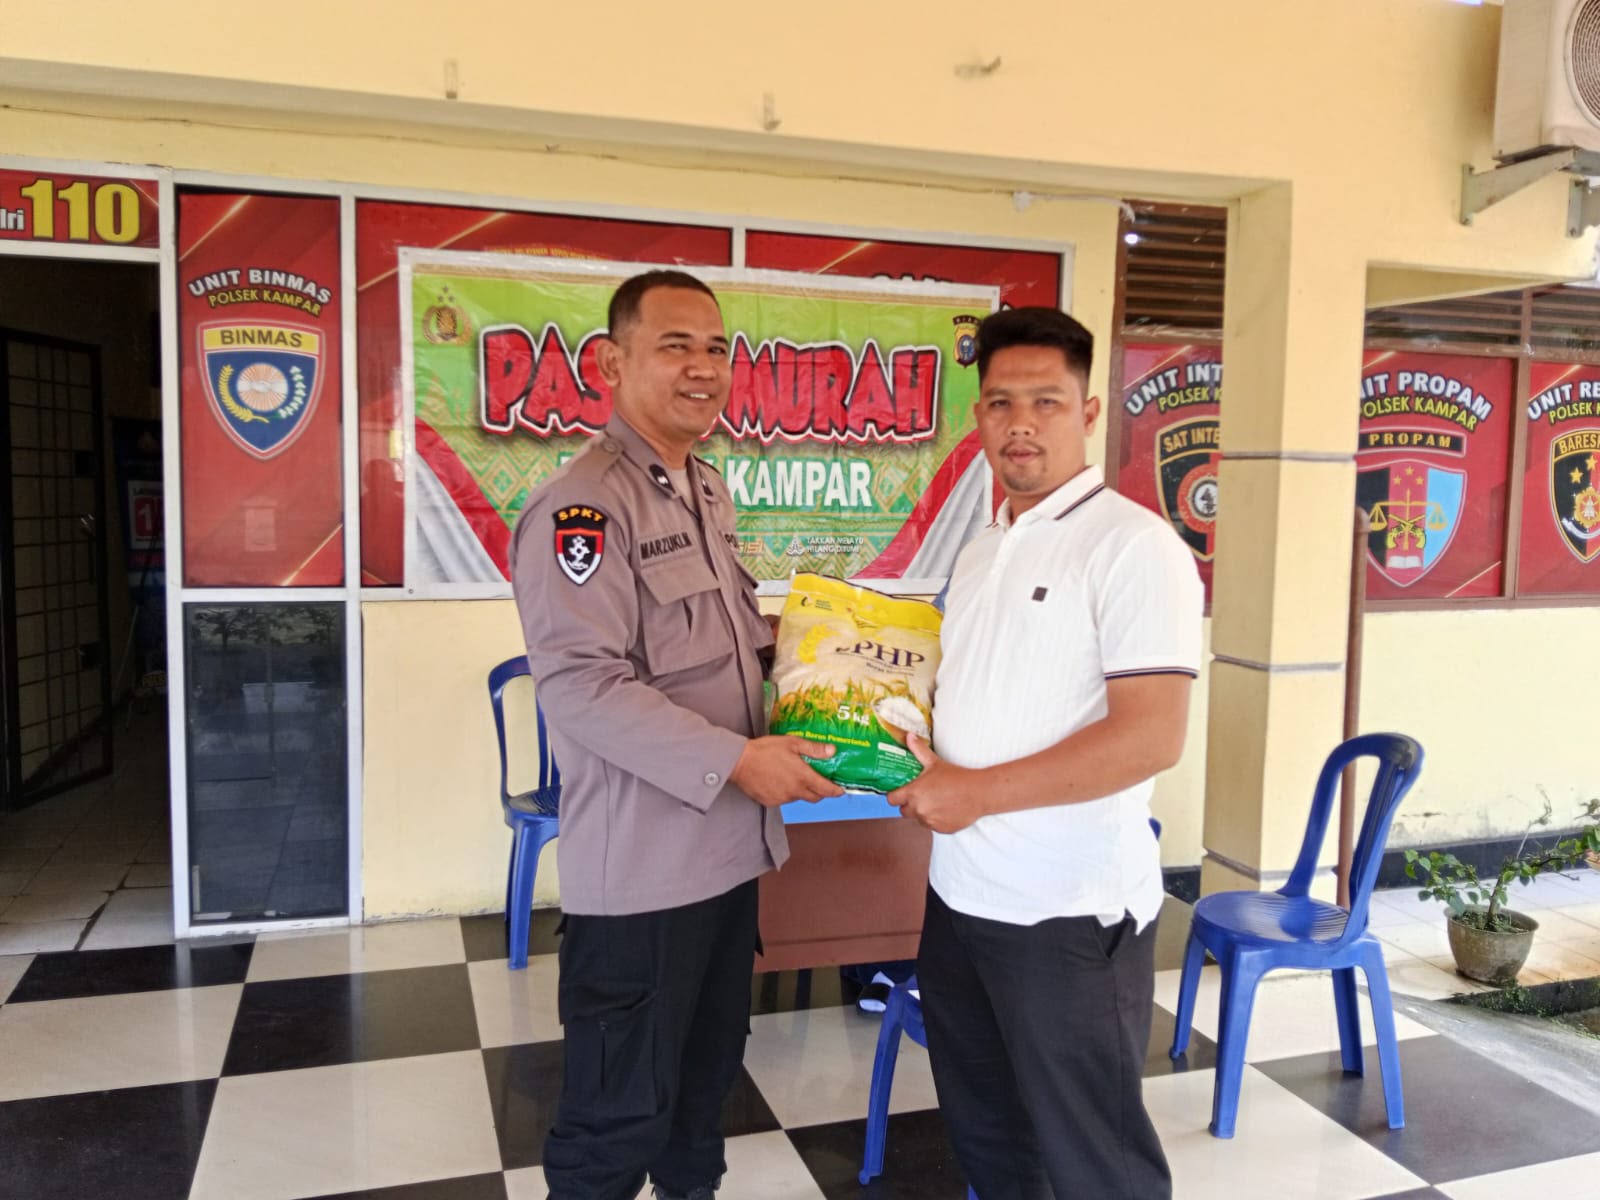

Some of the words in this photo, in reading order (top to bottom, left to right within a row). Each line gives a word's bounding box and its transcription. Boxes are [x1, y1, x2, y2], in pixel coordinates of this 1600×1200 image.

[0, 208, 24, 231] lri
[21, 178, 140, 244] 110
[188, 269, 241, 296] UNIT
[248, 269, 332, 303] BINMAS
[208, 289, 259, 307] POLSEK
[263, 290, 321, 316] KAMPAR
[220, 329, 303, 348] BINMAS
[480, 323, 616, 436] PAS
[720, 331, 941, 446] MURAH
[1126, 368, 1179, 414] UNIT
[1187, 364, 1224, 383] INT
[1360, 373, 1389, 399] IT
[1398, 371, 1492, 420] PROPAM
[1158, 387, 1210, 411] POLSEK
[1528, 383, 1573, 420] UNIT
[1580, 381, 1600, 398] RE
[1360, 396, 1411, 417] OLSEK
[1414, 396, 1477, 431] KAMPAR
[1549, 402, 1593, 424] POLSEK
[1163, 430, 1188, 452] SAT
[1190, 426, 1221, 444] INTE
[1369, 432, 1451, 448] PROPAM
[1559, 433, 1600, 454] BARES
[726, 459, 873, 507] KAMPAR
[558, 507, 603, 522] SPKT
[836, 704, 851, 721] 5
